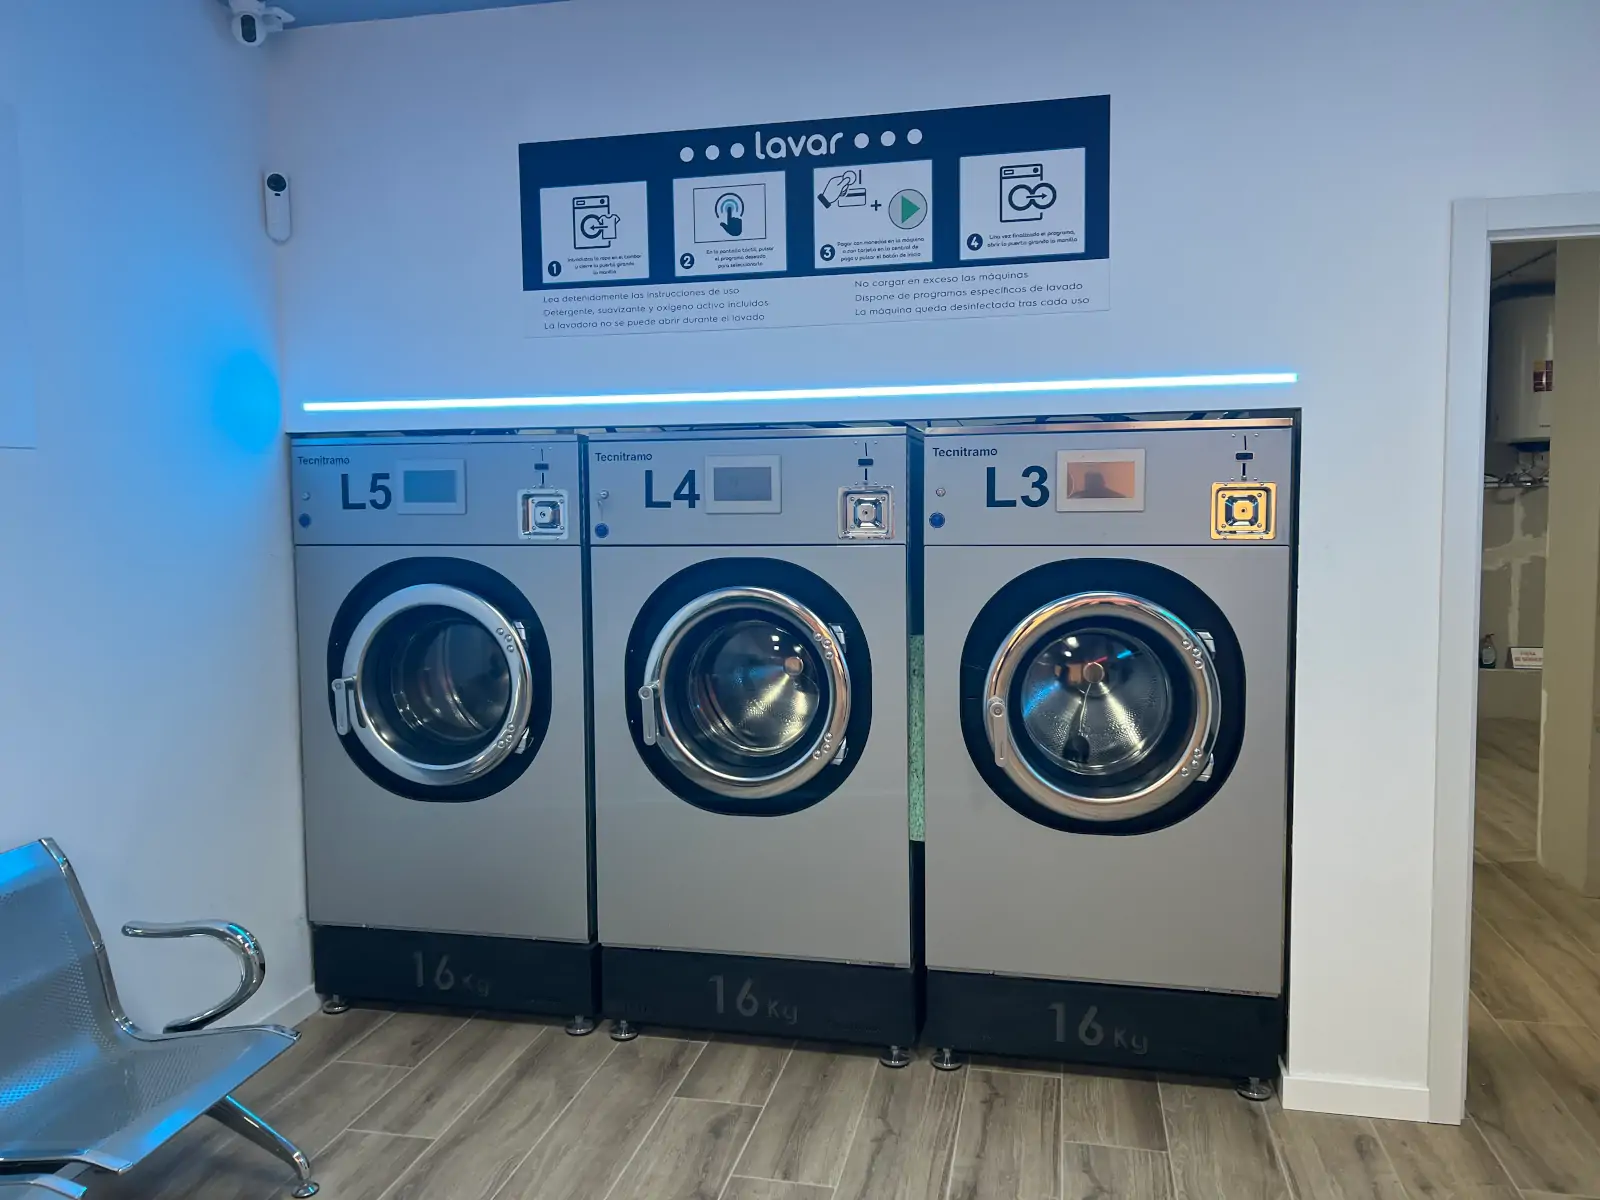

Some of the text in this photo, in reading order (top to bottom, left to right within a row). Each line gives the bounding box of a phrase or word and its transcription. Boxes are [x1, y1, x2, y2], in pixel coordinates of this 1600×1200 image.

[754, 130, 844, 160] lavar
[971, 236, 979, 248] 4
[823, 247, 831, 258] 3
[552, 263, 557, 274] 1
[684, 256, 690, 266] 2
[923, 276, 958, 284] exceso
[980, 272, 1029, 281] máquinas
[562, 292, 629, 302] detenidamente
[647, 290, 705, 299] instrucciones
[856, 293, 894, 302] Dispone
[914, 290, 967, 300] programas
[1046, 282, 1083, 291] lavado
[543, 308, 594, 317] Detergente,
[597, 305, 646, 314] suavizante
[697, 302, 725, 310] activo
[728, 300, 769, 308] incluidos
[870, 306, 912, 315] máquina
[915, 304, 946, 314] queda
[950, 301, 1015, 311] desinfectada
[558, 321, 597, 329] lavadora
[627, 319, 656, 327] puede
[658, 317, 680, 325] abrir
[683, 315, 718, 324] durante
[732, 313, 764, 321] lavado
[595, 451, 652, 463] Tecnitramo
[932, 446, 998, 458] Tecnitramo
[298, 455, 350, 466] Tecnitramo
[340, 472, 392, 510] L5
[644, 470, 700, 509] L4
[985, 465, 1050, 508] L3
[413, 950, 454, 991] 16
[709, 974, 759, 1017] 16
[1048, 1002, 1104, 1046] 16
